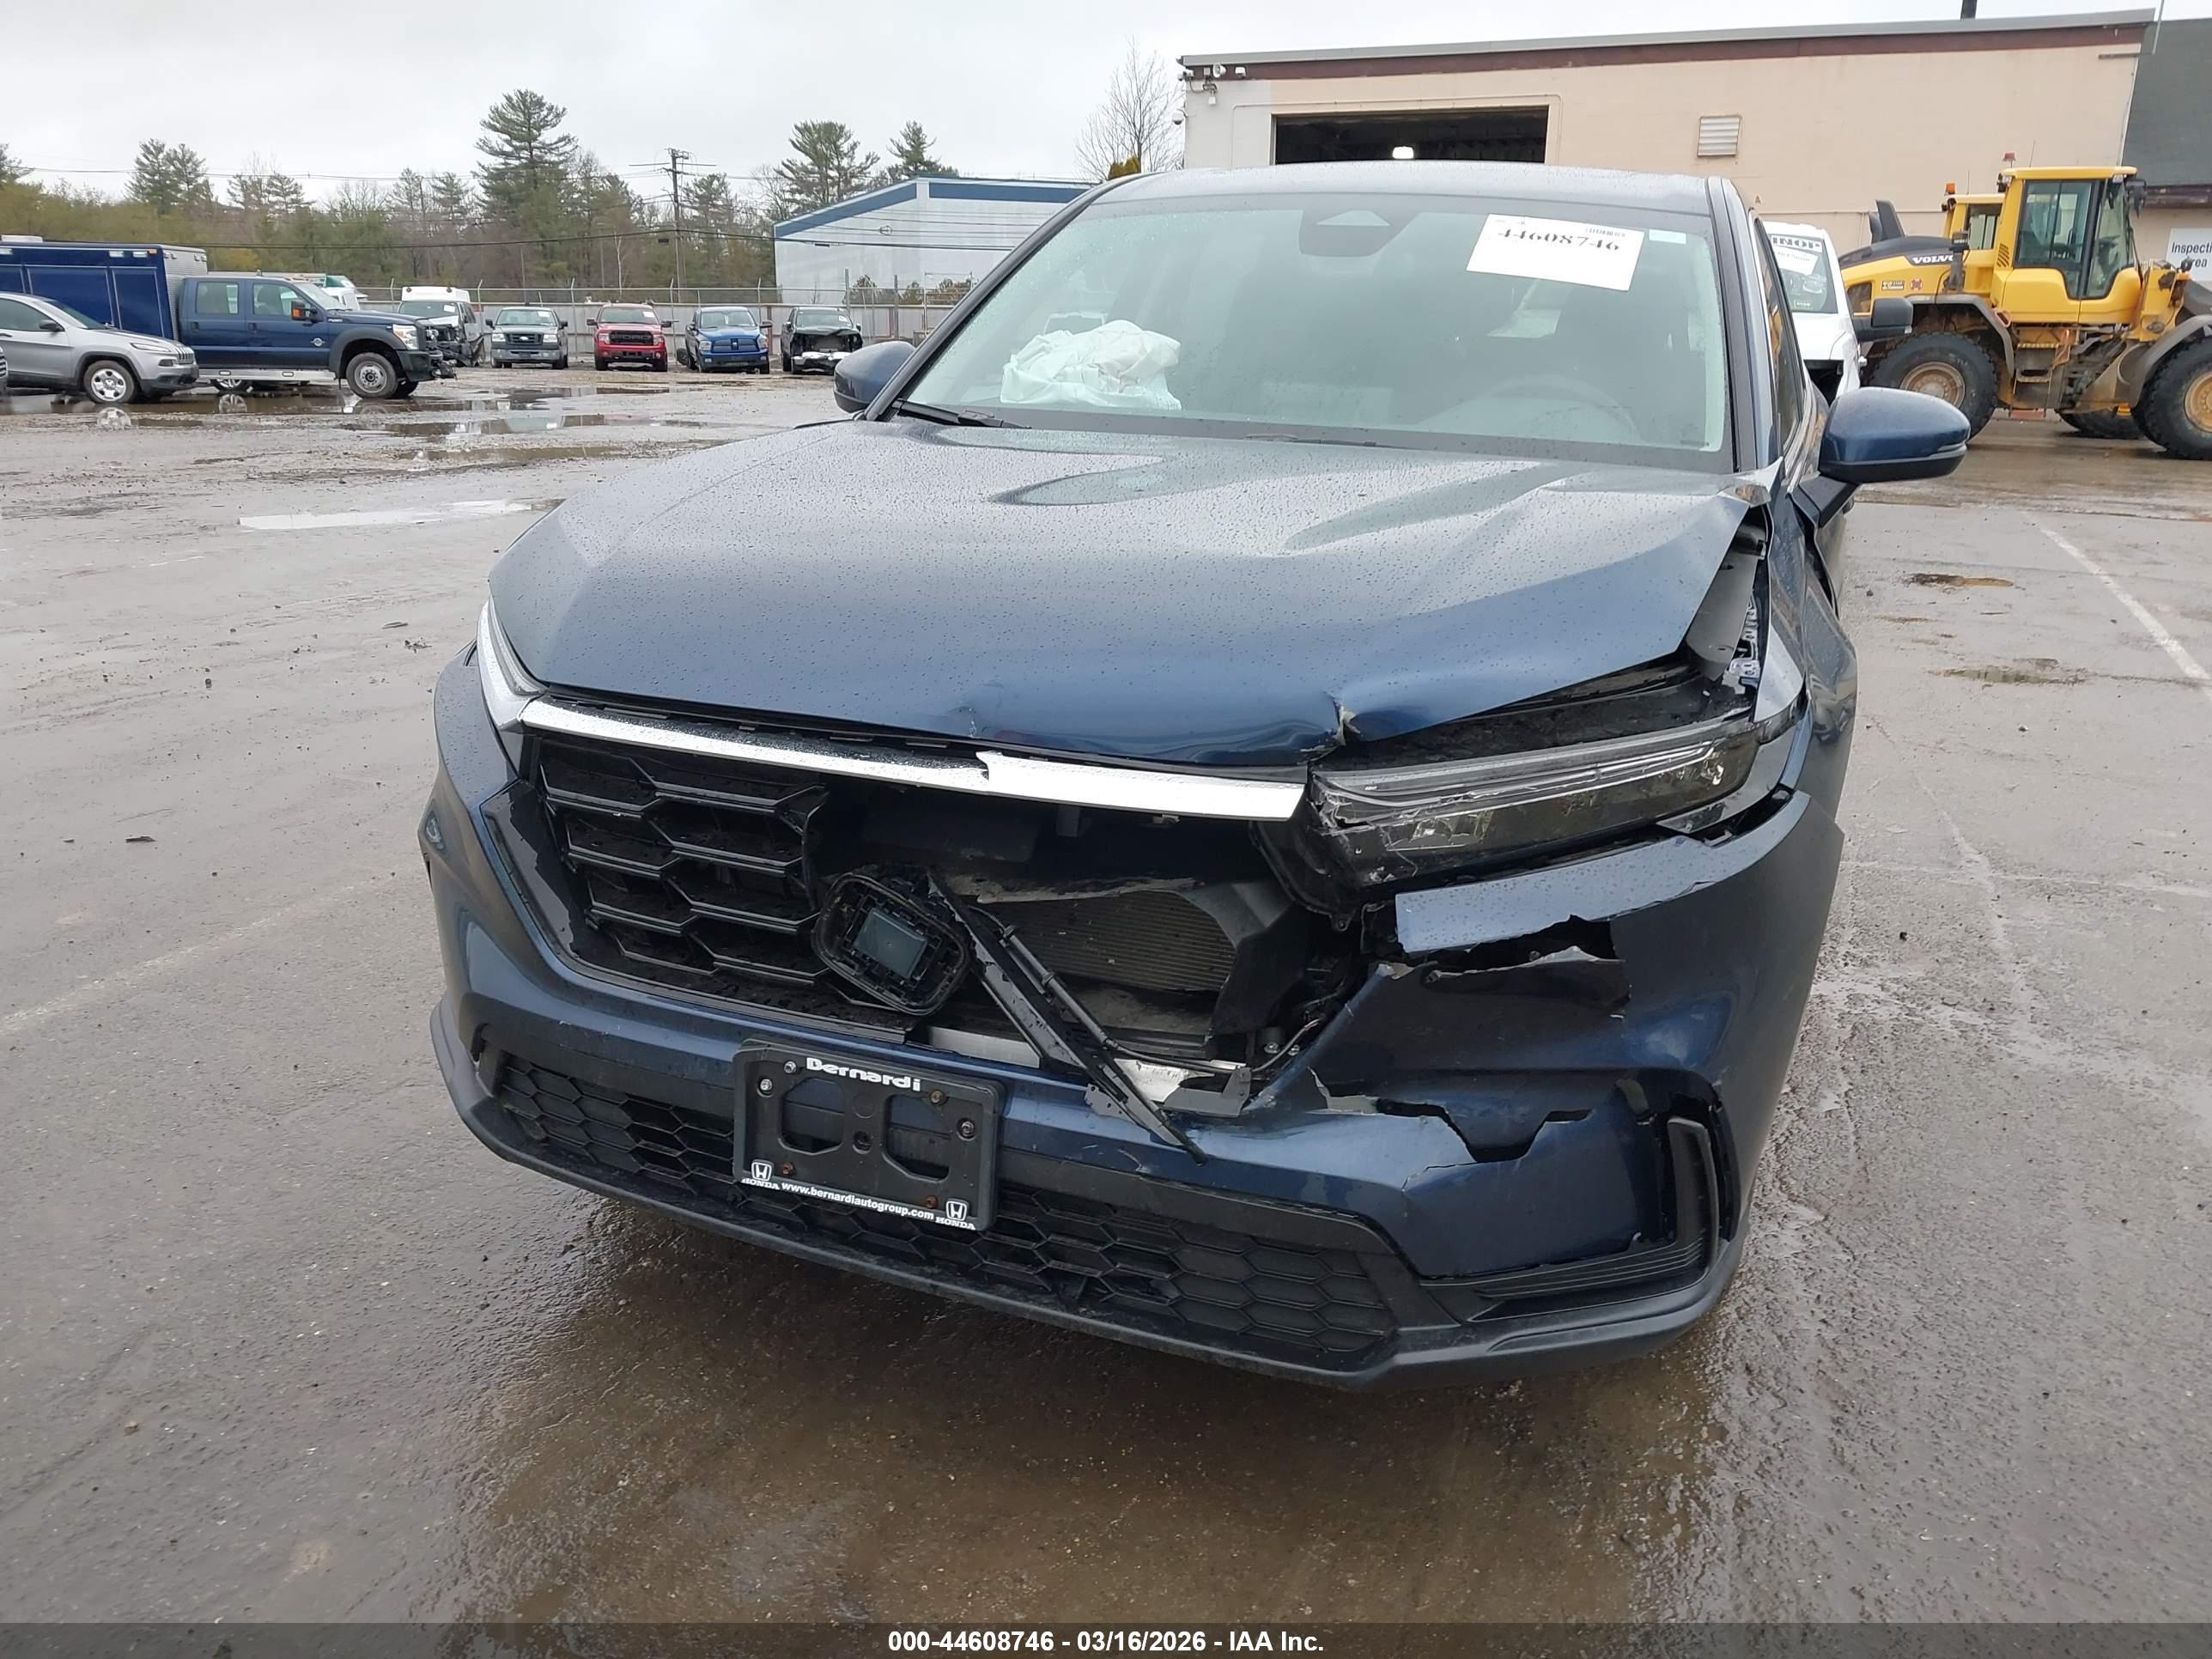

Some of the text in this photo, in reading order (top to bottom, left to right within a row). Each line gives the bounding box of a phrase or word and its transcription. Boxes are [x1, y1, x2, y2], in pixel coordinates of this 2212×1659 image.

[1498, 228, 1620, 251] 44608746
[806, 1057, 921, 1091] Bernardi
[741, 1178, 976, 1231] HONDA www.bernardiautogroup.com HONDA
